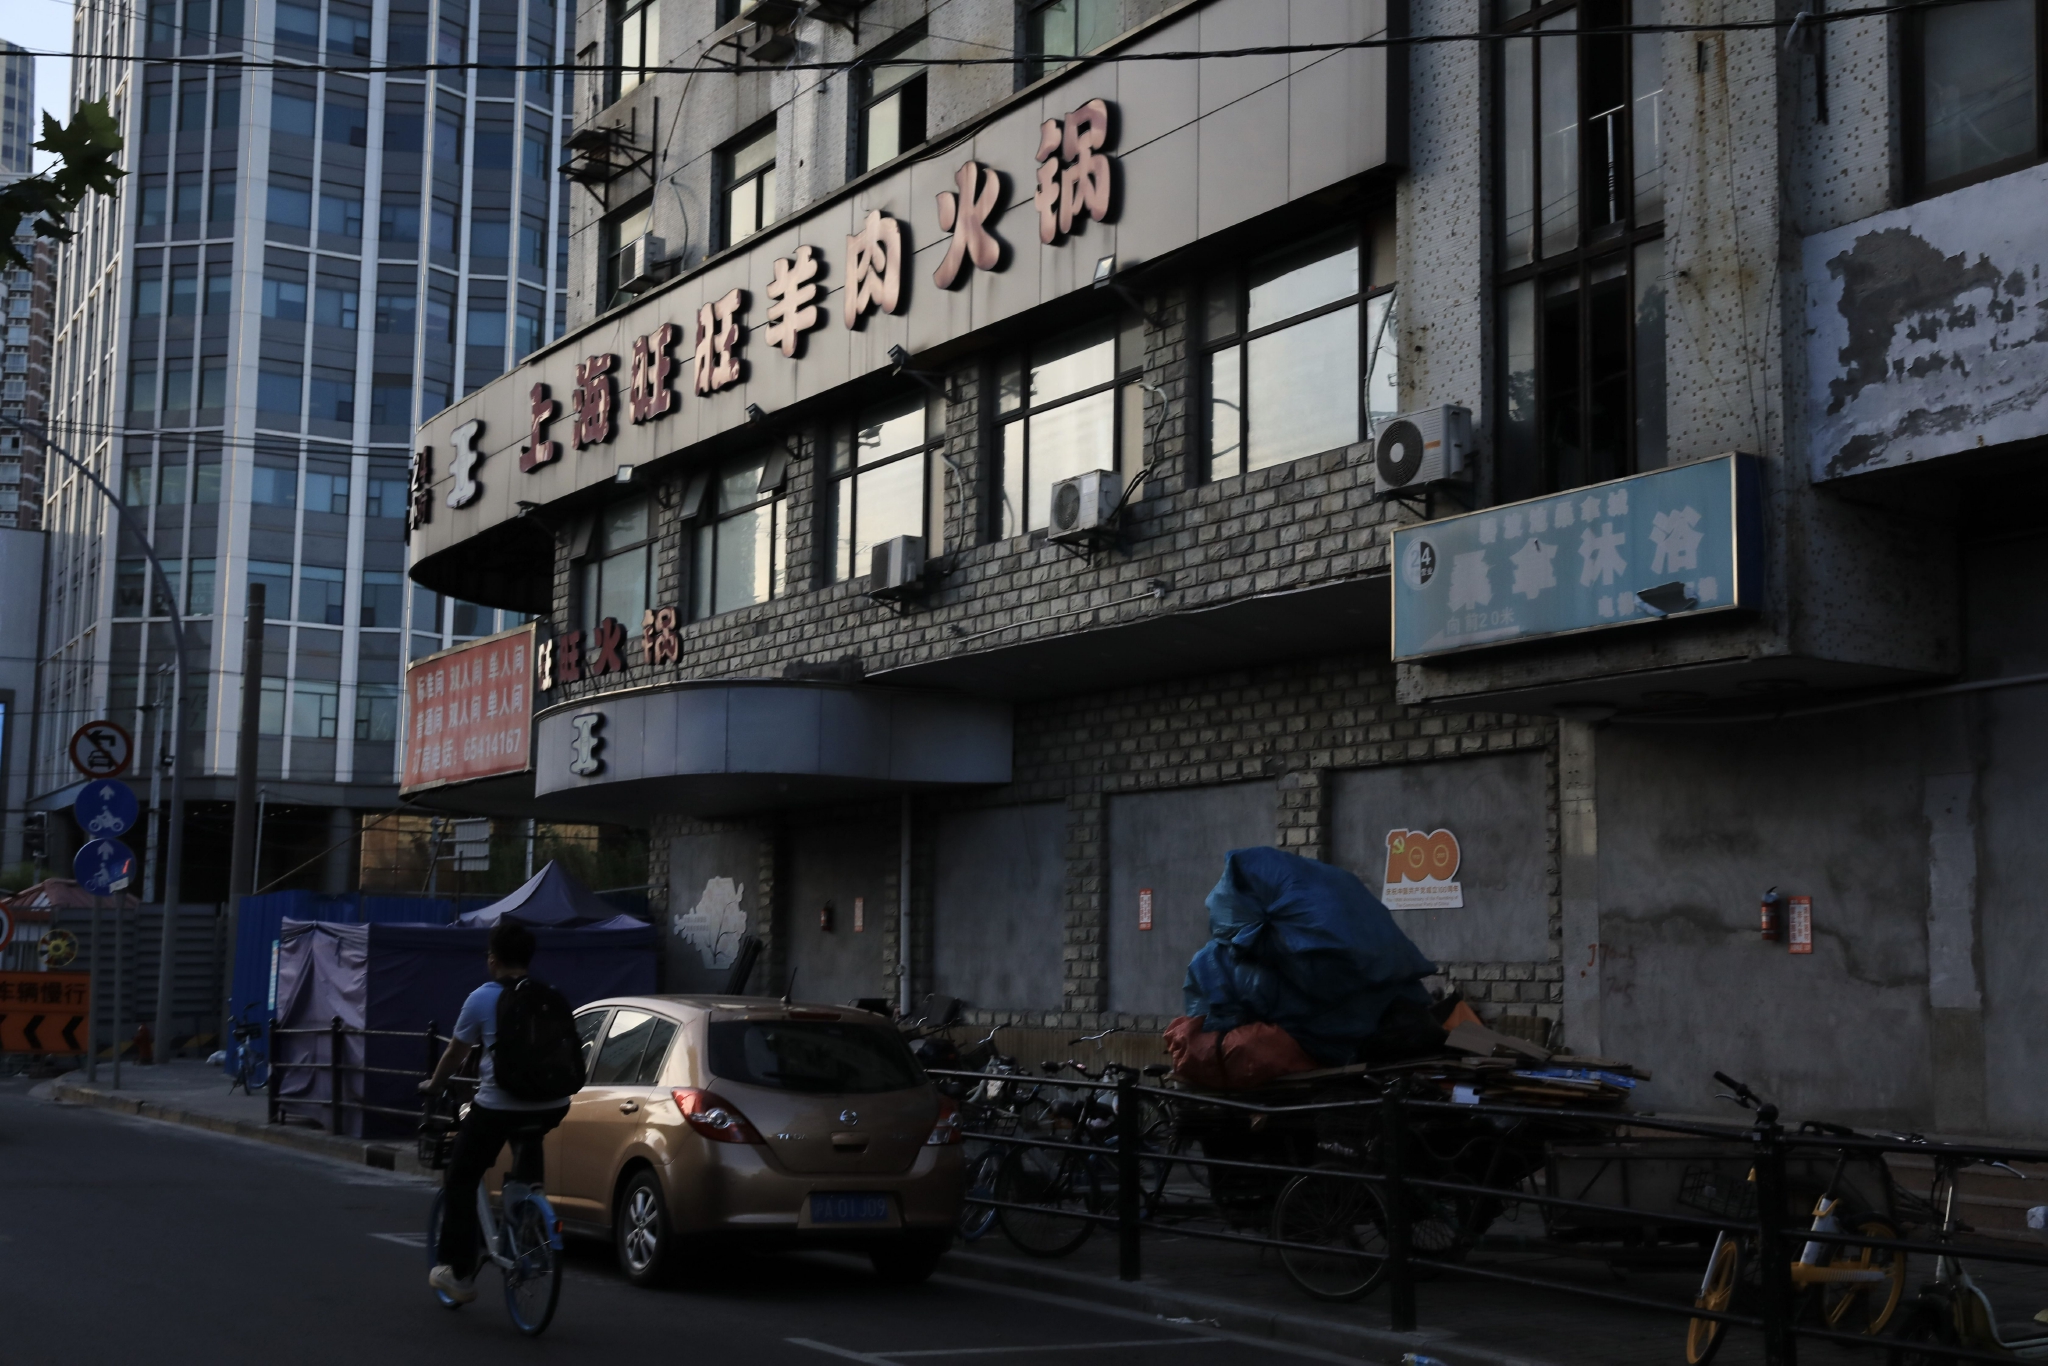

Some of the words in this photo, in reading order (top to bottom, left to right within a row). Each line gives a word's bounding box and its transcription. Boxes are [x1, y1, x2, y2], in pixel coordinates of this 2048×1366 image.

[518, 98, 1112, 473] 上海旺旺羊肉火锅
[1446, 610, 1515, 637] 向前20米
[488, 645, 525, 682] 单人间
[486, 684, 524, 720] 单人间
[463, 728, 522, 762] 65414167
[1386, 830, 1459, 883] 100
